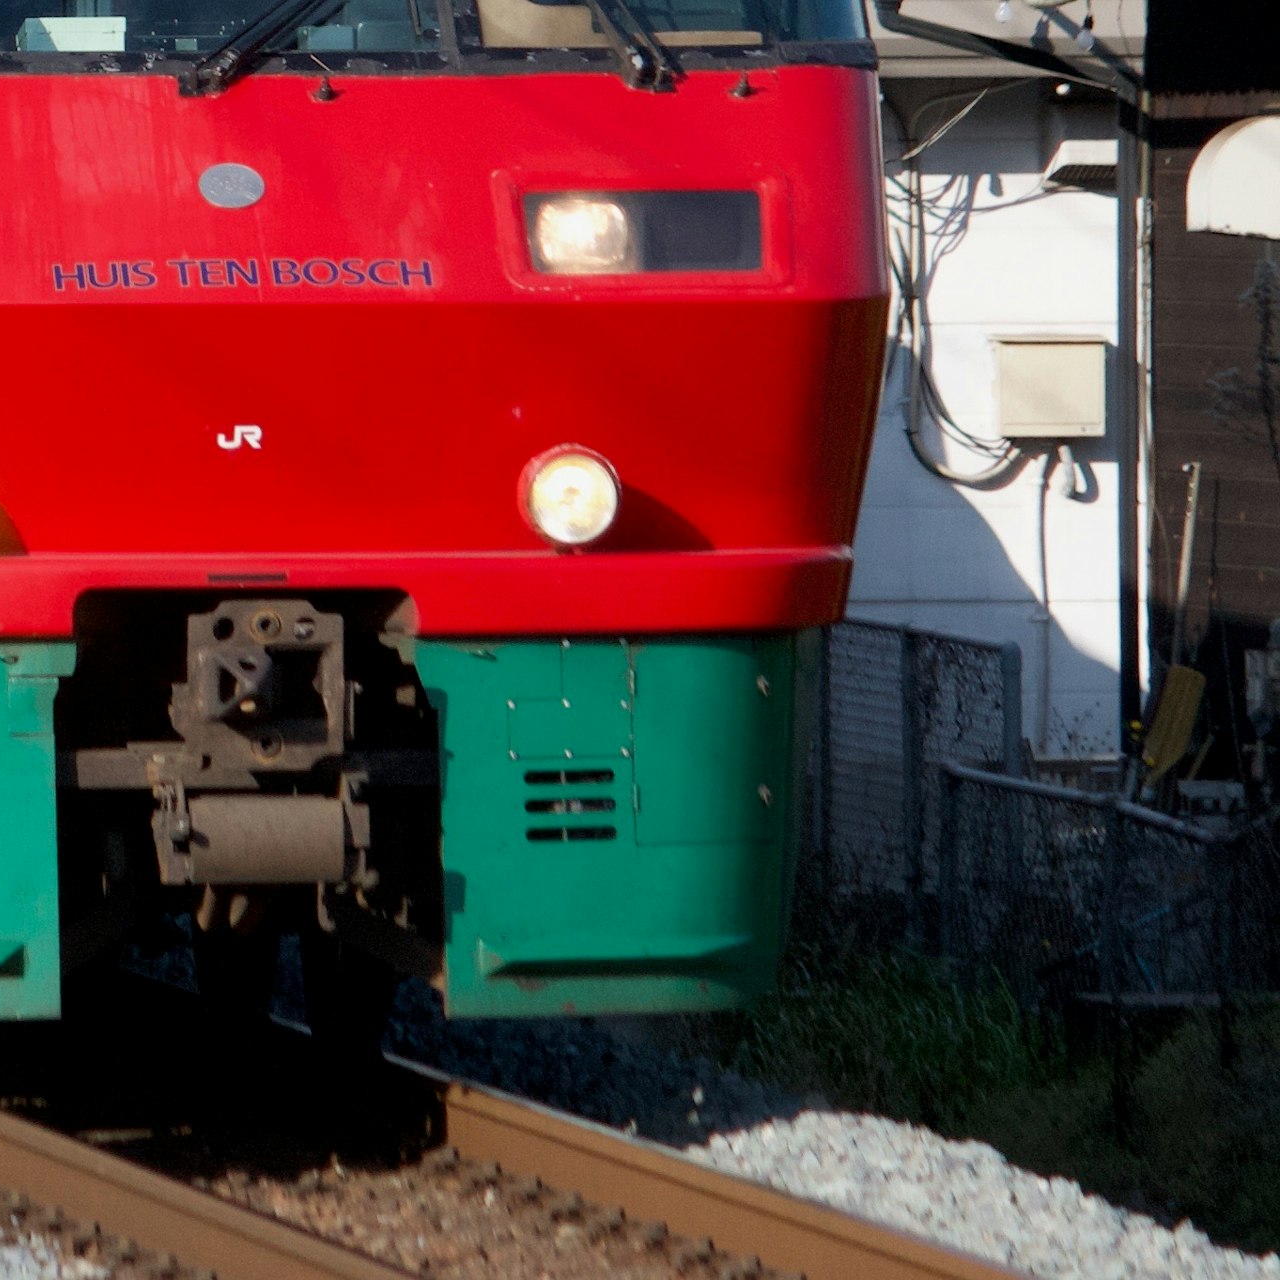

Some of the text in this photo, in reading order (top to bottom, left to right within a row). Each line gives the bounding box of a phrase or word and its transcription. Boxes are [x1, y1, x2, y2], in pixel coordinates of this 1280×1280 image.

[52, 258, 434, 291] HUIS TEN BOSCH
[217, 424, 263, 450] JR
